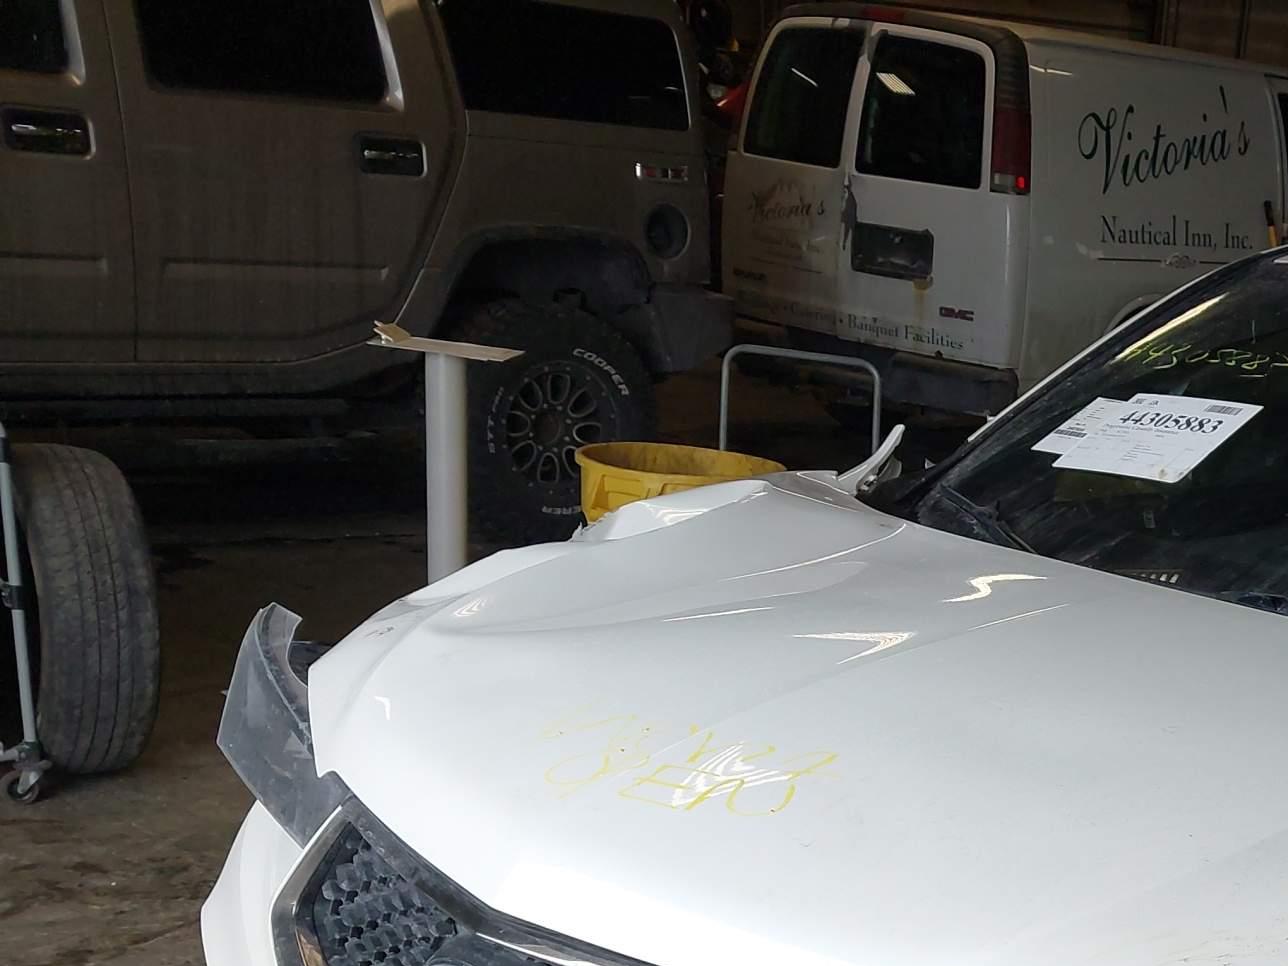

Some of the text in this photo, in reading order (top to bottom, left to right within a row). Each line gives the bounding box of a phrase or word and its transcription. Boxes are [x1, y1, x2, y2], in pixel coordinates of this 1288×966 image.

[1078, 85, 1251, 195] Victoria's
[1100, 215, 1253, 250] Nautical Inn, Inc.
[848, 313, 899, 339] Banquet
[904, 325, 965, 350] Facilities
[572, 347, 630, 397] COOPER
[1119, 409, 1224, 434] 44305883
